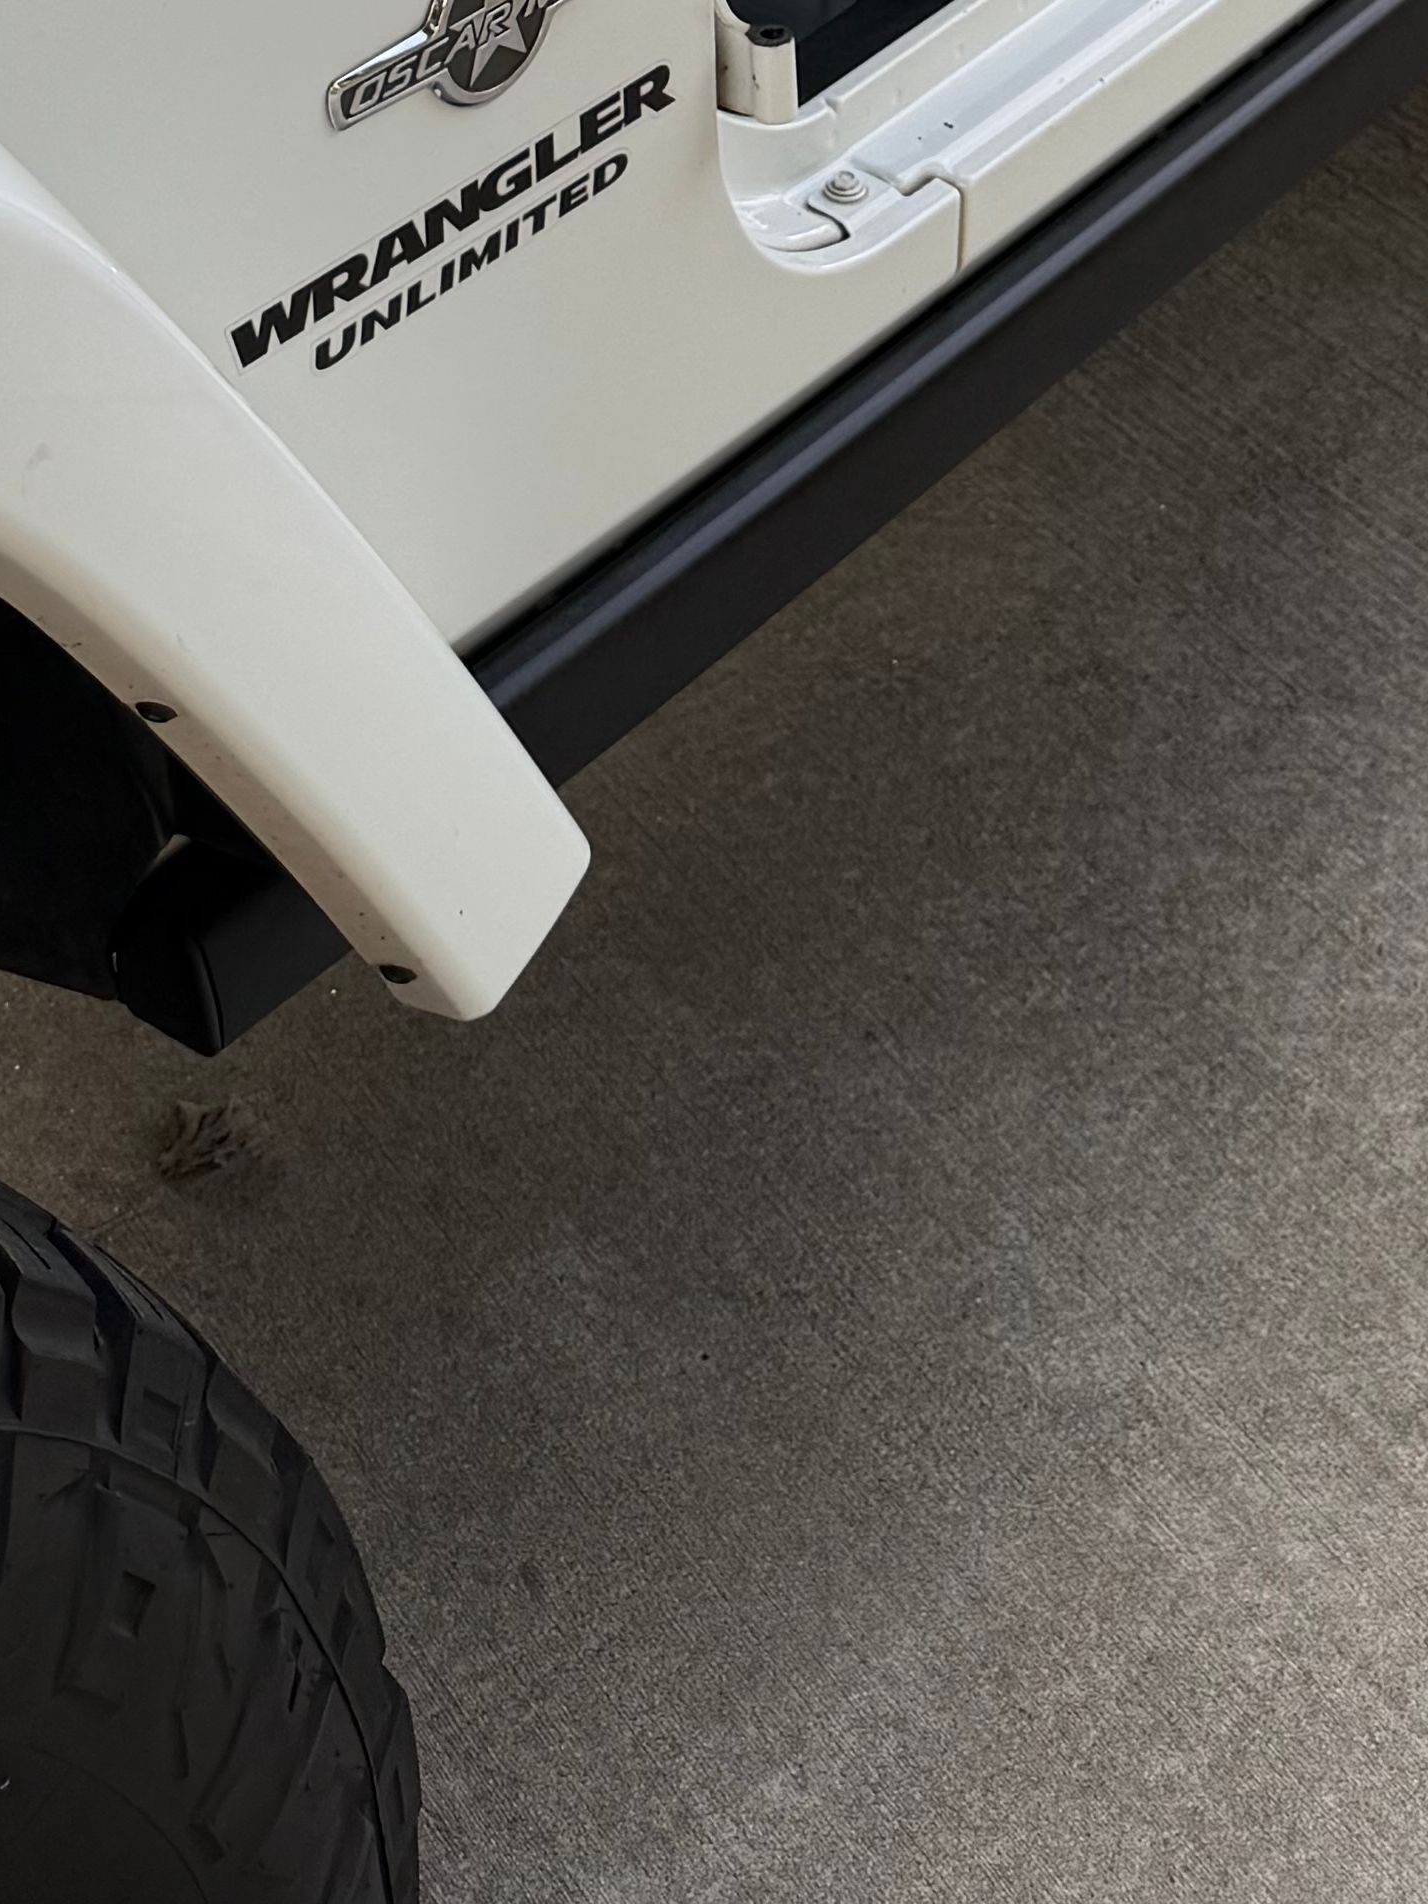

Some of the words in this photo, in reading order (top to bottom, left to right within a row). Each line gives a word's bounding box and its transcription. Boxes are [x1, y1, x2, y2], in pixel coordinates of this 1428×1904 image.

[350, 0, 511, 116] OSCAR
[231, 64, 676, 368] WRANGLER
[316, 154, 628, 370] UNLIMITED
